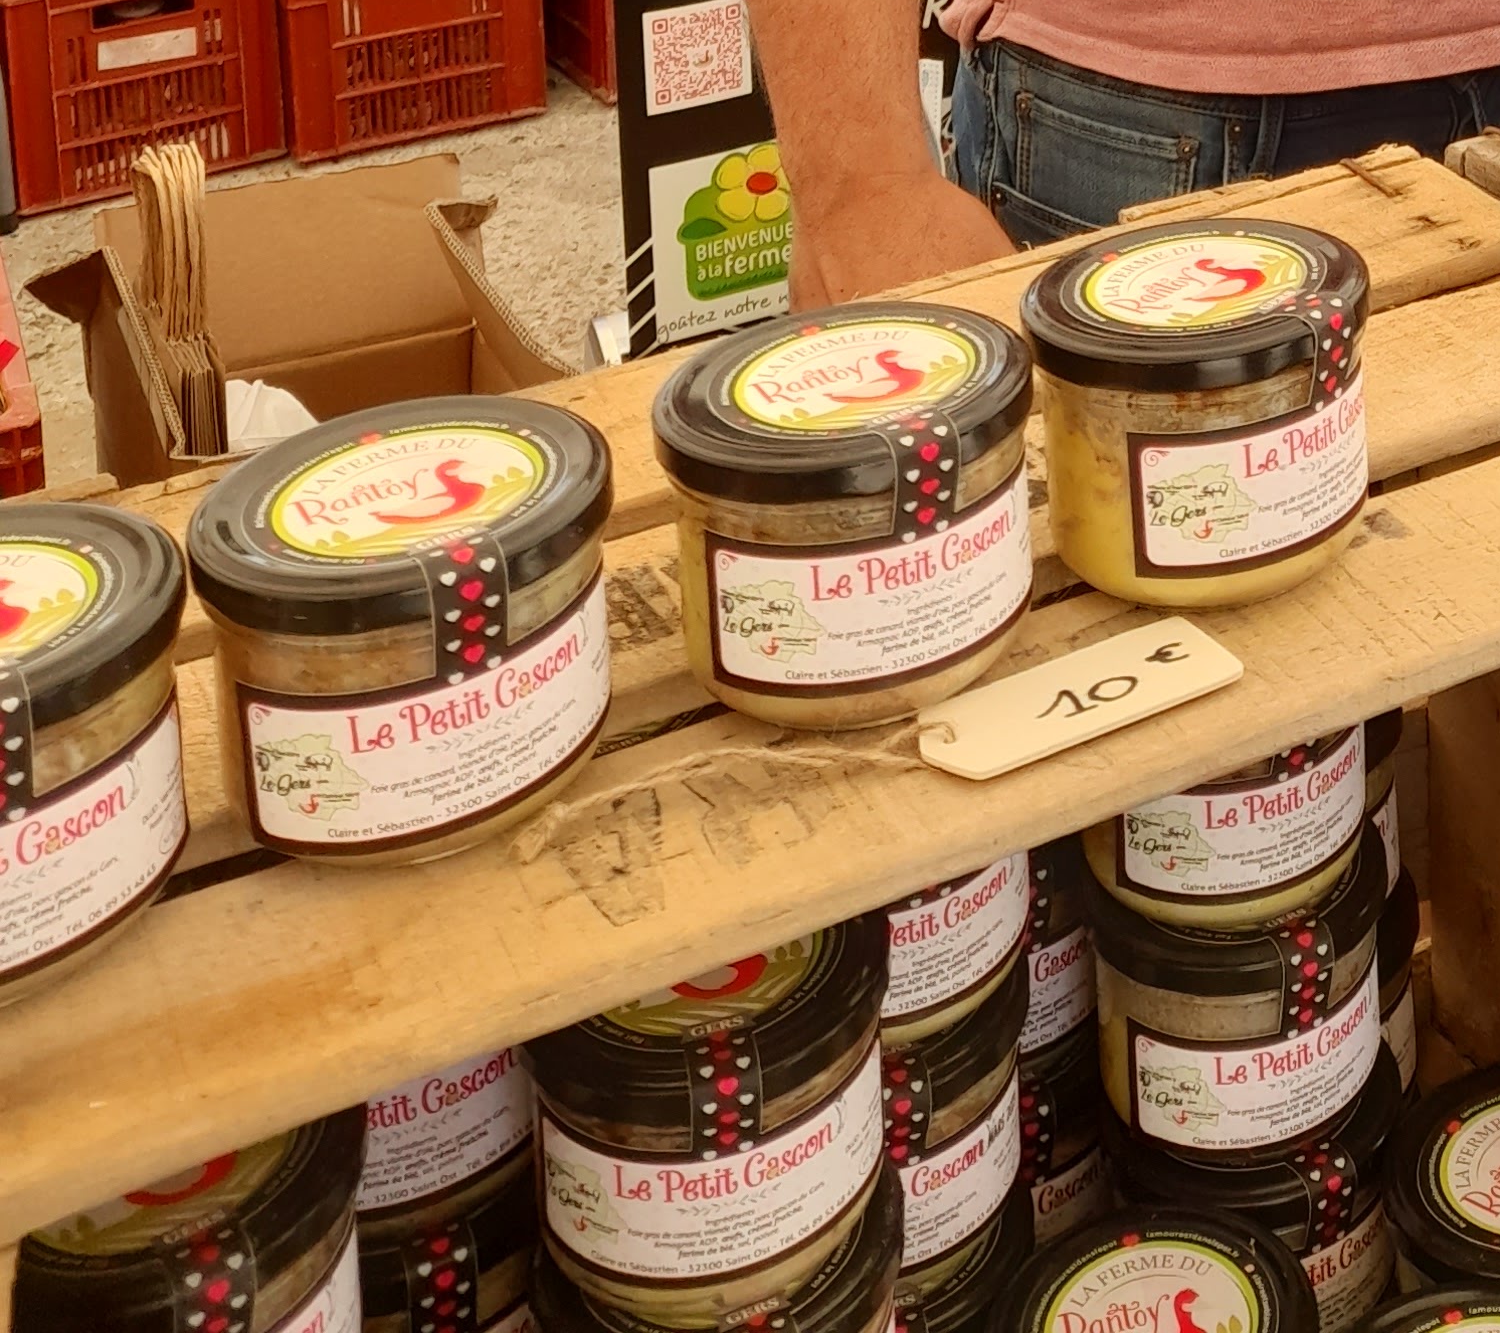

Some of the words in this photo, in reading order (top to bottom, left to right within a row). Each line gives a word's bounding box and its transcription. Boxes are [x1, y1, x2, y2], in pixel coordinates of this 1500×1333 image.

[696, 222, 793, 262] BIENVENUE
[697, 265, 706, 281] à
[708, 264, 722, 279] la
[725, 244, 793, 277] ferme
[1110, 251, 1169, 286] FERME
[1172, 243, 1204, 258] DU
[724, 295, 771, 318] notre
[787, 333, 865, 364] FERME
[868, 330, 910, 341] DU
[335, 440, 430, 477] FERME
[434, 437, 479, 451] DU
[1242, 443, 1279, 478] Le
[1282, 416, 1336, 466] Petit
[810, 564, 852, 601] Le
[857, 549, 936, 595] Petit
[941, 508, 1011, 572] Gascon
[1219, 544, 1247, 558] Claire
[1250, 543, 1259, 552] et
[1261, 530, 1303, 550] Sébastien
[784, 670, 817, 680] Claire
[820, 671, 829, 680] et
[830, 664, 883, 680] Sébastien
[891, 653, 926, 670] 32300
[927, 642, 951, 661] Saint
[346, 715, 395, 755] Le
[399, 691, 490, 743] Petit
[495, 633, 582, 709] Gascon
[1036, 674, 1139, 721] 10
[327, 827, 359, 839] Claire
[362, 827, 374, 836] et
[377, 813, 434, 834] Sébastien
[445, 795, 482, 817] 32300
[485, 780, 513, 802] Saint
[1204, 800, 1238, 830] Le
[1243, 787, 1304, 824] Petit
[1307, 746, 1357, 802] Gascon
[15, 785, 127, 865] Gascon
[943, 866, 1007, 929] Gascon
[1218, 878, 1261, 891] Sébastien
[88, 909, 103, 923] 06
[1214, 1056, 1249, 1086] Le
[1252, 1042, 1314, 1083] Petit
[1316, 996, 1369, 1058] Gascon
[421, 1047, 517, 1114] Gascon
[613, 1164, 652, 1201] Le
[657, 1168, 738, 1203] Petit
[743, 1121, 834, 1188] Gascon
[1230, 1134, 1271, 1147] Sébastien
[910, 1138, 985, 1198] Gascon
[1455, 1168, 1471, 1190] LA
[688, 1260, 723, 1274] 32300
[725, 1252, 753, 1267] Saint
[754, 1245, 772, 1258] Ost
[1070, 1283, 1099, 1309] LA
[1096, 1253, 1175, 1286] FERME
[1180, 1255, 1216, 1278] DU
